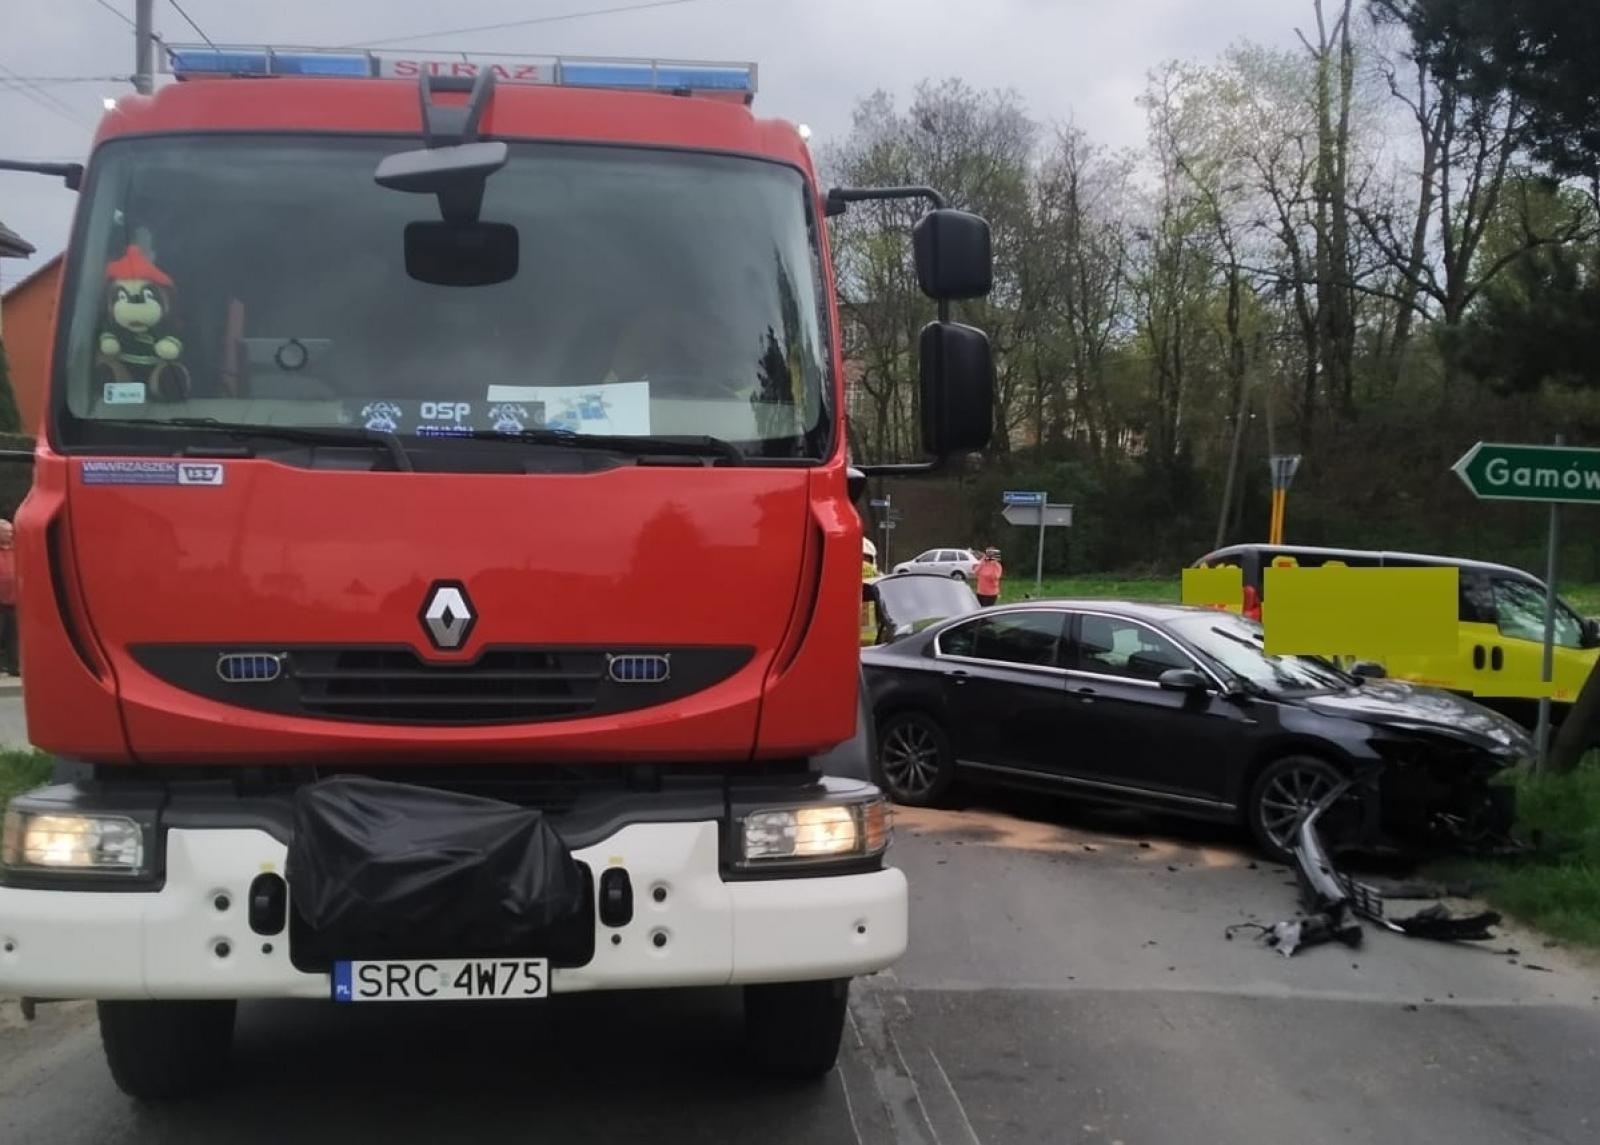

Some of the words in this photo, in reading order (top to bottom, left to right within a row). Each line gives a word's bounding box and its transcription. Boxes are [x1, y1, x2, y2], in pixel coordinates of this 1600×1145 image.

[420, 402, 471, 423] OSP
[336, 984, 350, 995] PL
[358, 963, 439, 998] SRC
[453, 961, 542, 997] 4W75
